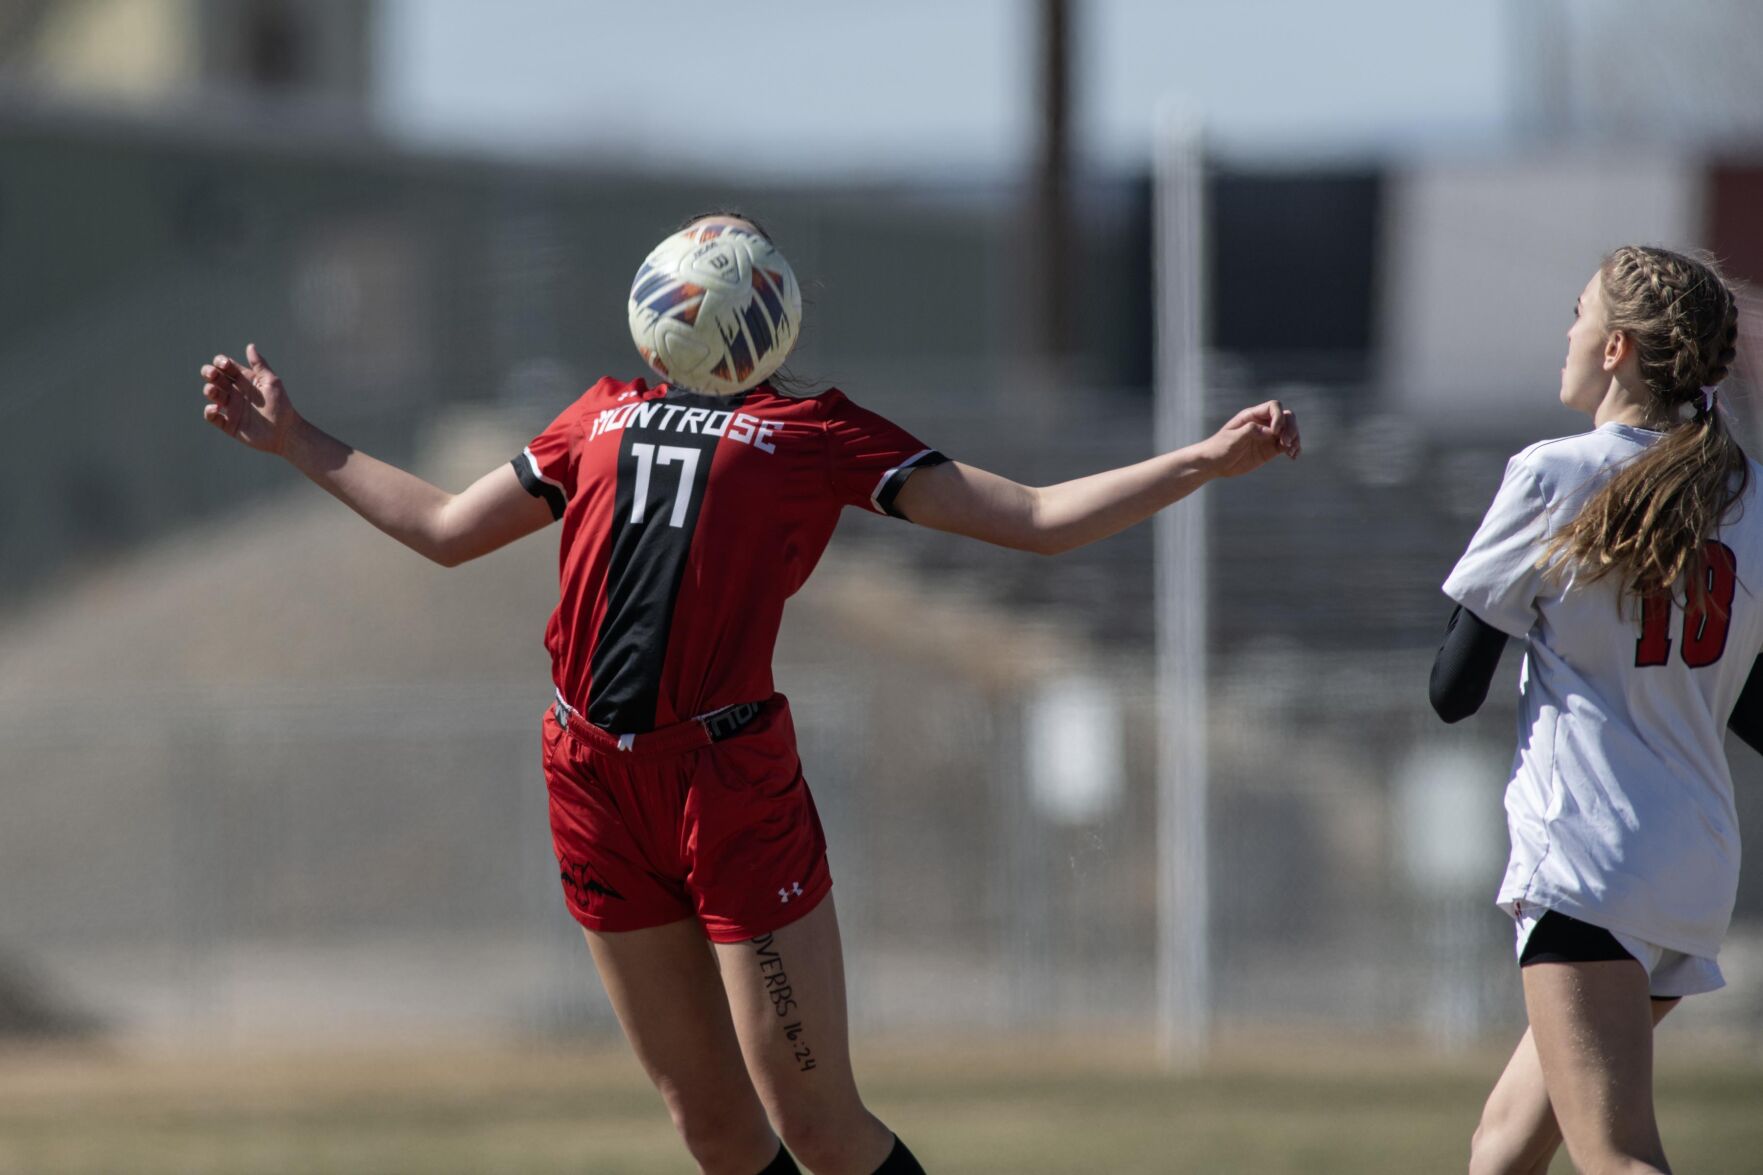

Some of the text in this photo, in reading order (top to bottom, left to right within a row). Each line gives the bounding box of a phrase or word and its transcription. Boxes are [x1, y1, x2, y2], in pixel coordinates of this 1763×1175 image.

[589, 402, 784, 455] MONTROSE
[630, 442, 701, 528] 17
[783, 1021, 817, 1073] 16:24
